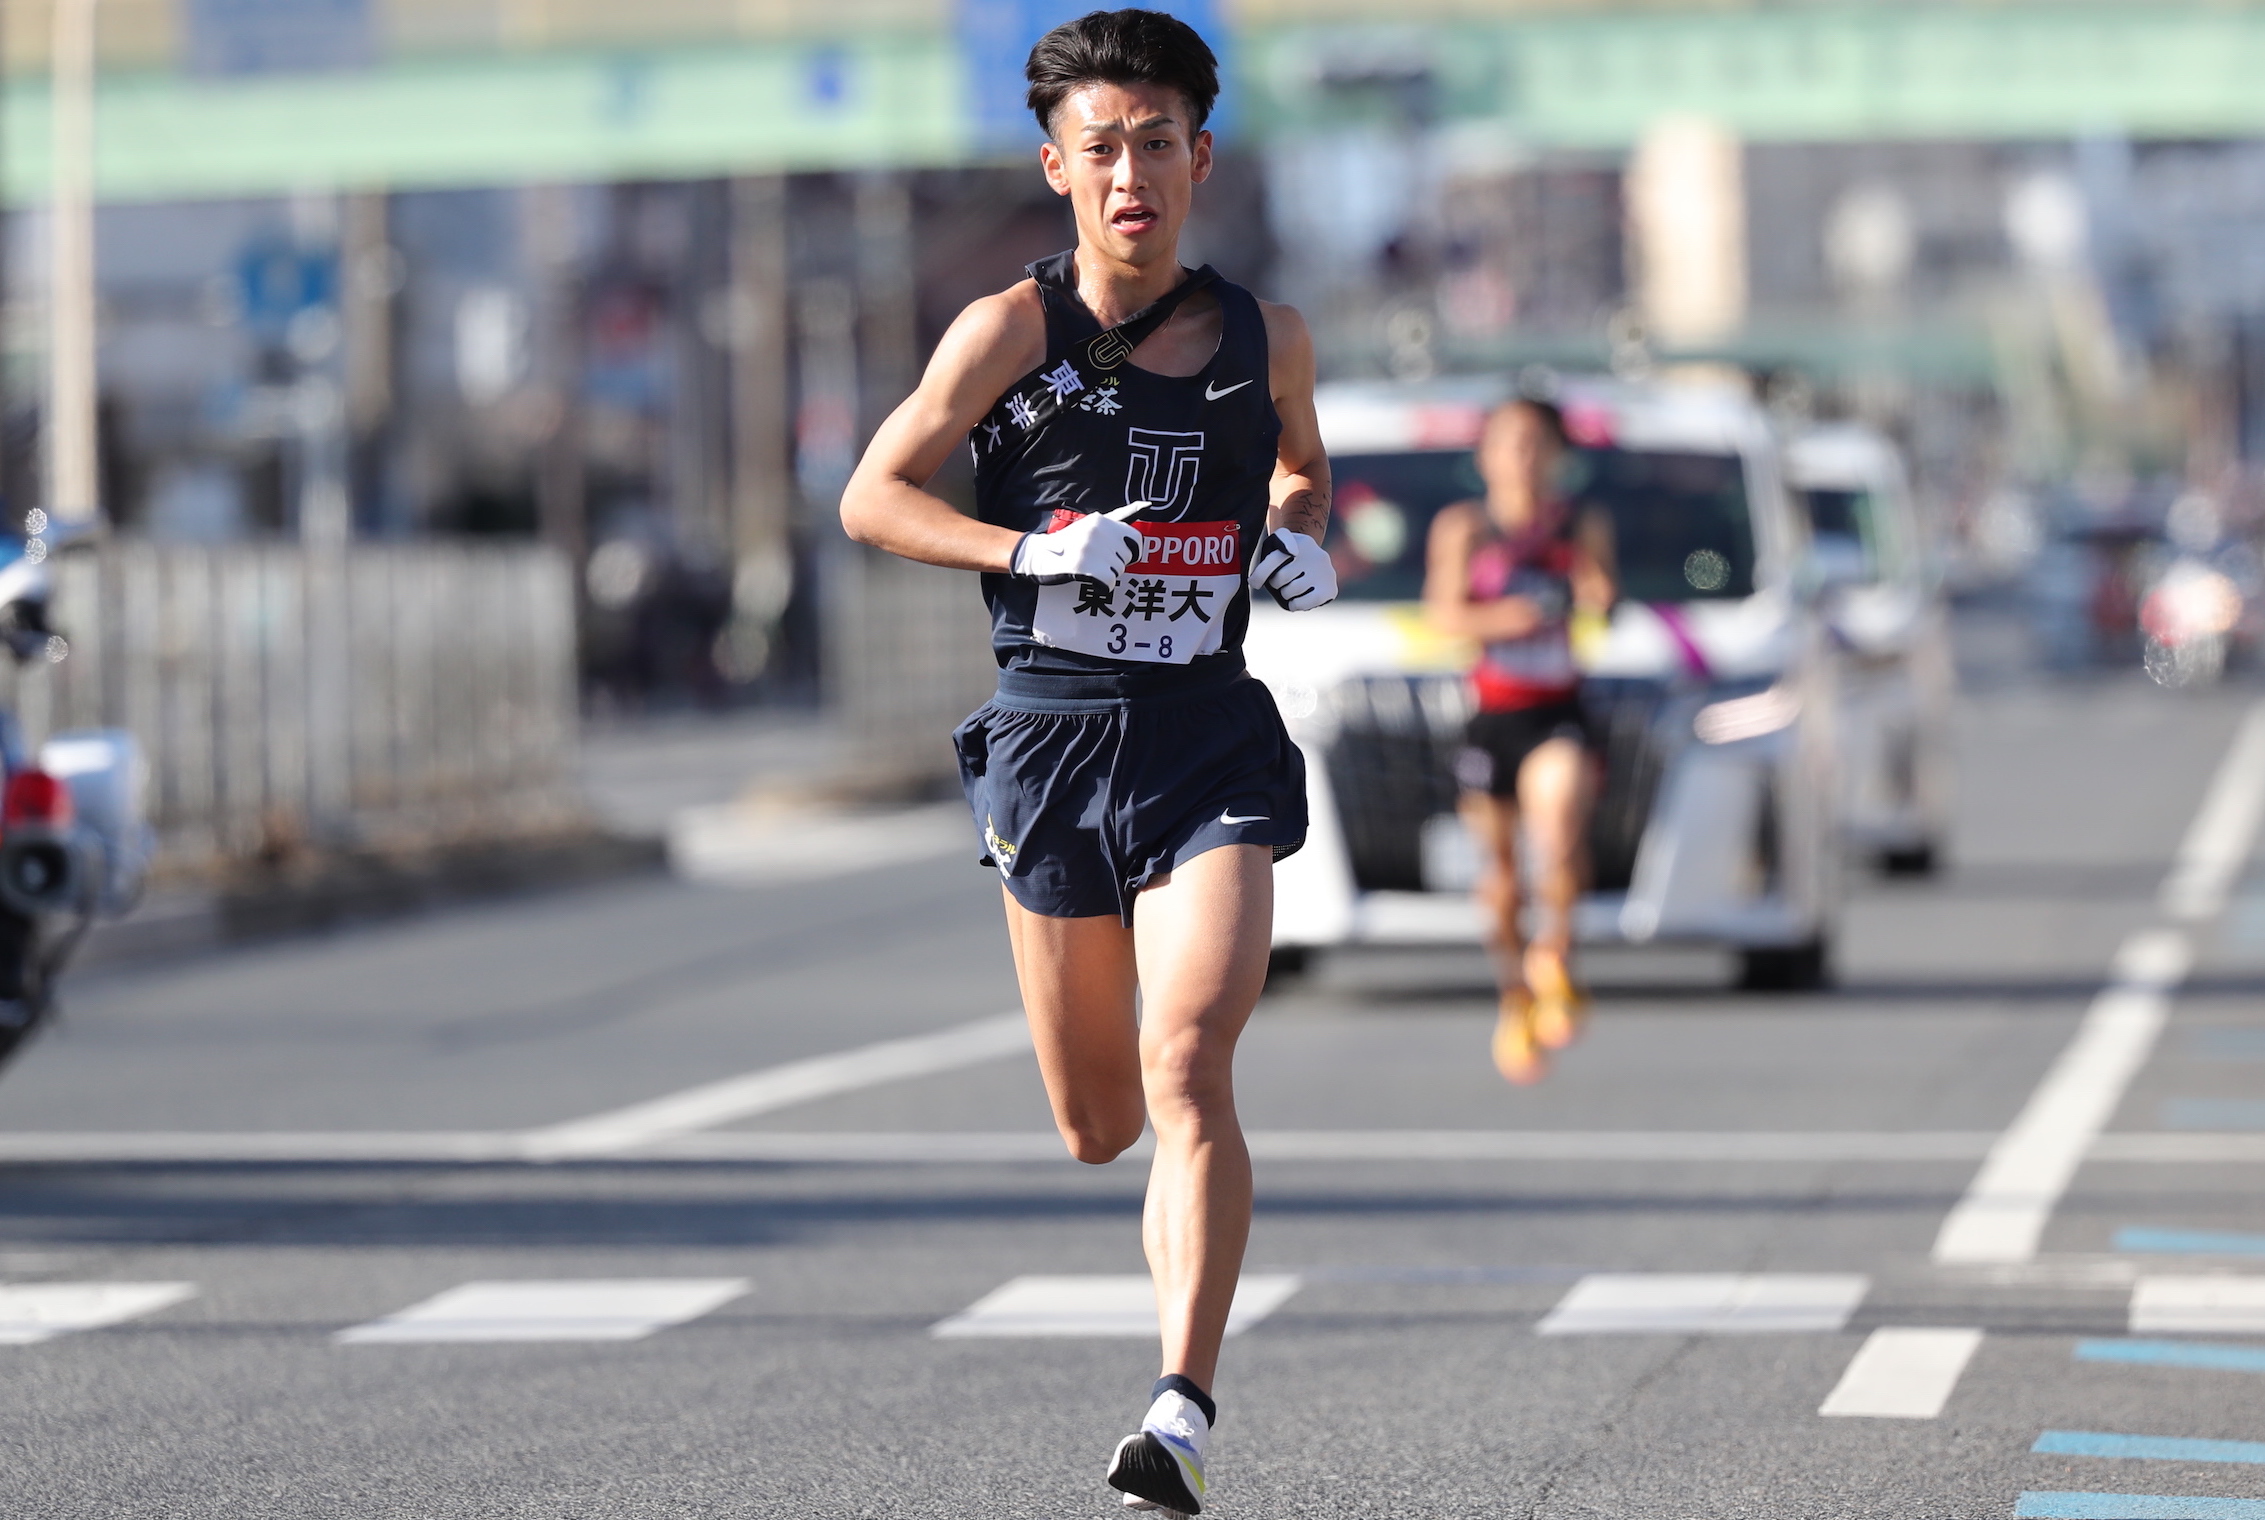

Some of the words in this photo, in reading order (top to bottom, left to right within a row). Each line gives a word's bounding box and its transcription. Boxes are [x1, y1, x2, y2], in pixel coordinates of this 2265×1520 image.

[1140, 534, 1235, 565] PPORO
[1072, 578, 1214, 624] 東洋大
